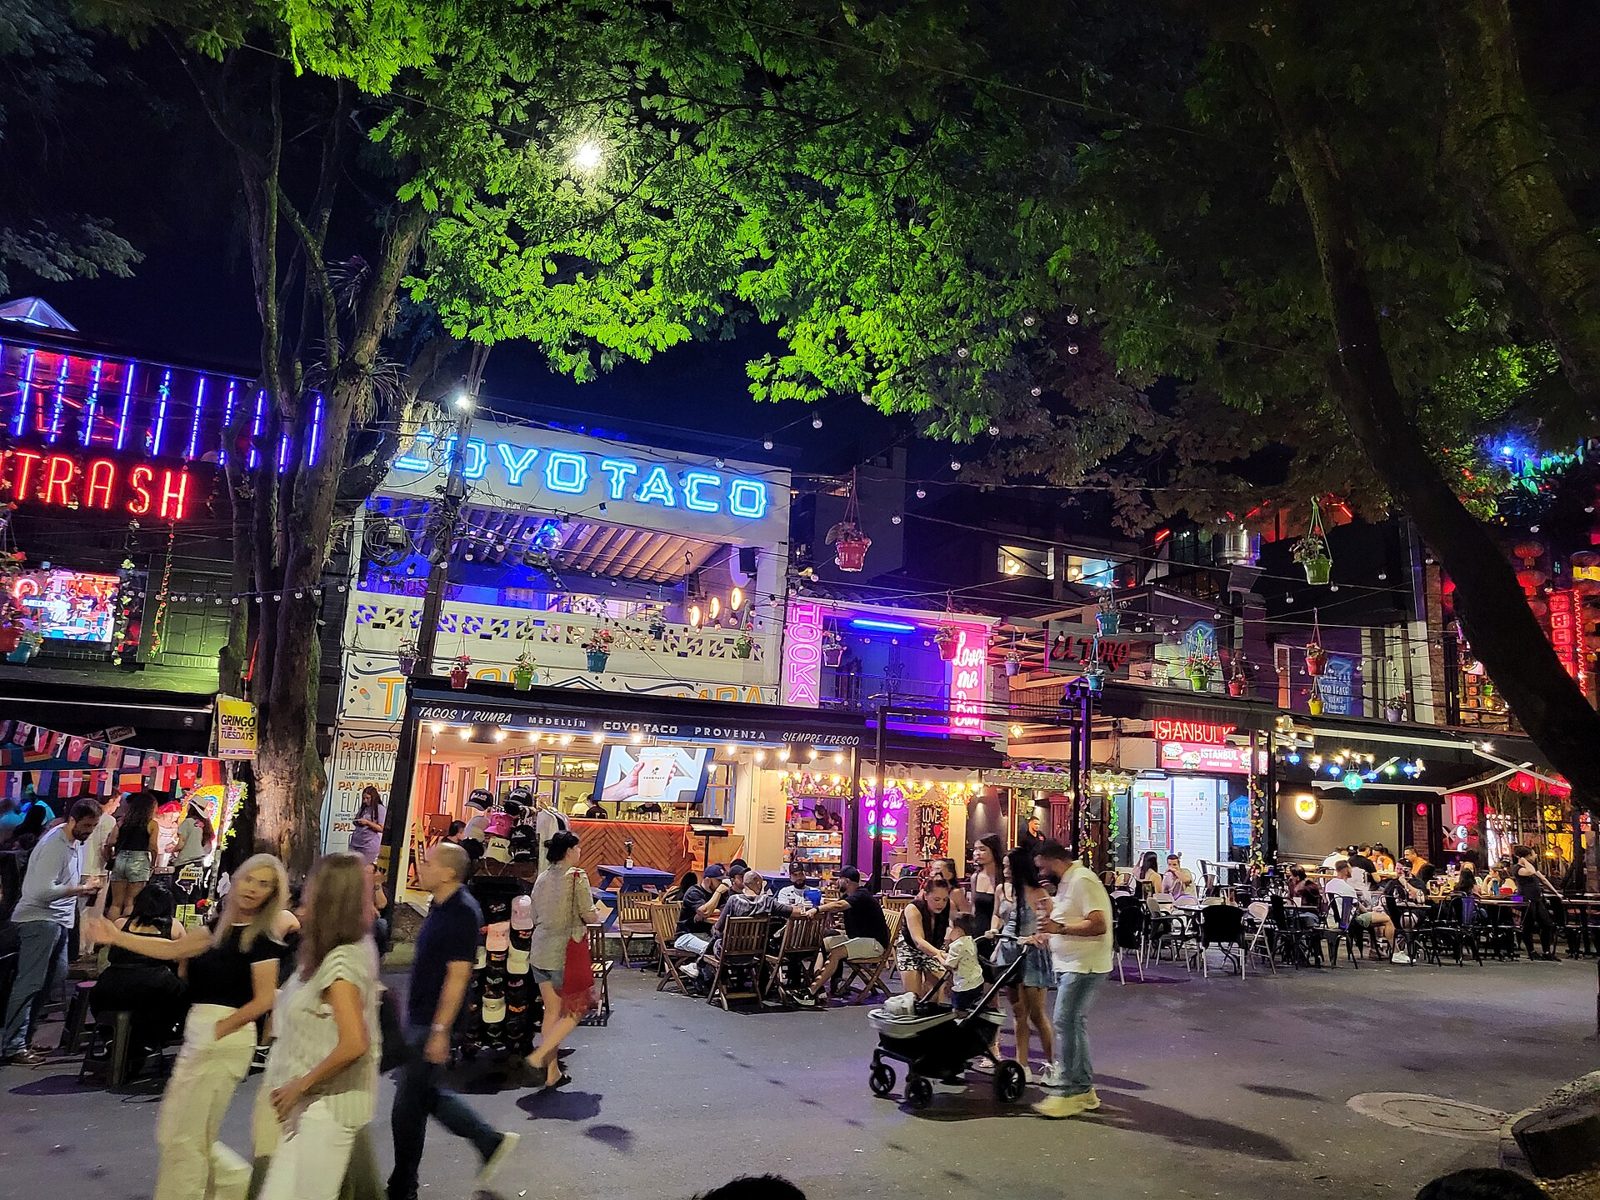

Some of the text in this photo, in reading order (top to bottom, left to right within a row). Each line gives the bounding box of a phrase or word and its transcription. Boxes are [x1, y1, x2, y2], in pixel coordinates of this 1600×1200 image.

[16, 452, 187, 519] TRASH
[600, 459, 768, 519] TACO
[788, 603, 821, 704] HOOKA
[221, 714, 256, 727] GRINGO
[418, 707, 513, 724] TACOS Y RUMBA
[528, 716, 586, 728] MEDELLÍN
[603, 721, 678, 734] COYO TACO
[694, 727, 766, 740] PROVENZA
[1155, 720, 1220, 743] ISTANBUL
[221, 731, 254, 741] TUESDAYS
[781, 731, 860, 746] SIEMPRE FRESCO
[359, 742, 398, 752] ARRIBA
[922, 807, 940, 823] LOVE
